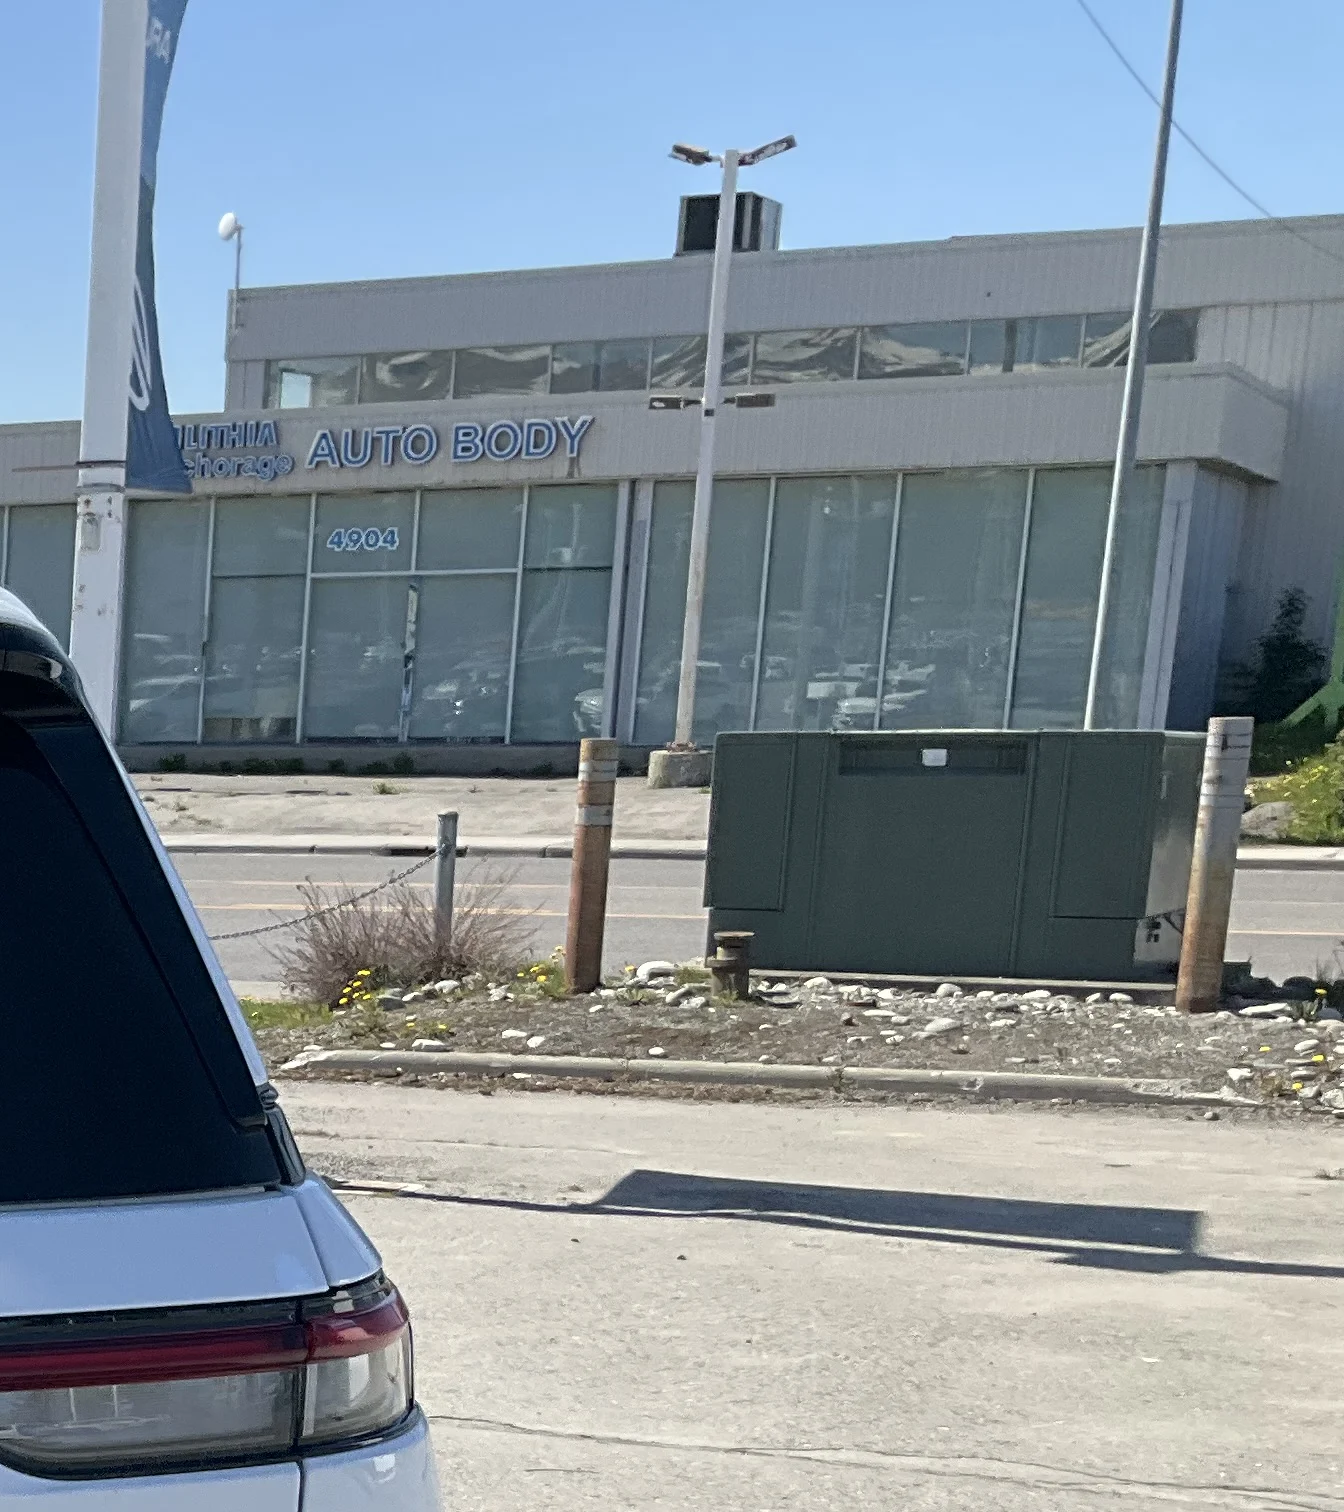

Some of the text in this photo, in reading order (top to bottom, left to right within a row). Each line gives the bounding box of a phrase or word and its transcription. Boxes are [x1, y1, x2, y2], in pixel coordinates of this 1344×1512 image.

[184, 421, 277, 450] LITHIA
[306, 414, 595, 470] AUTO BODY
[325, 526, 400, 552] 4904
